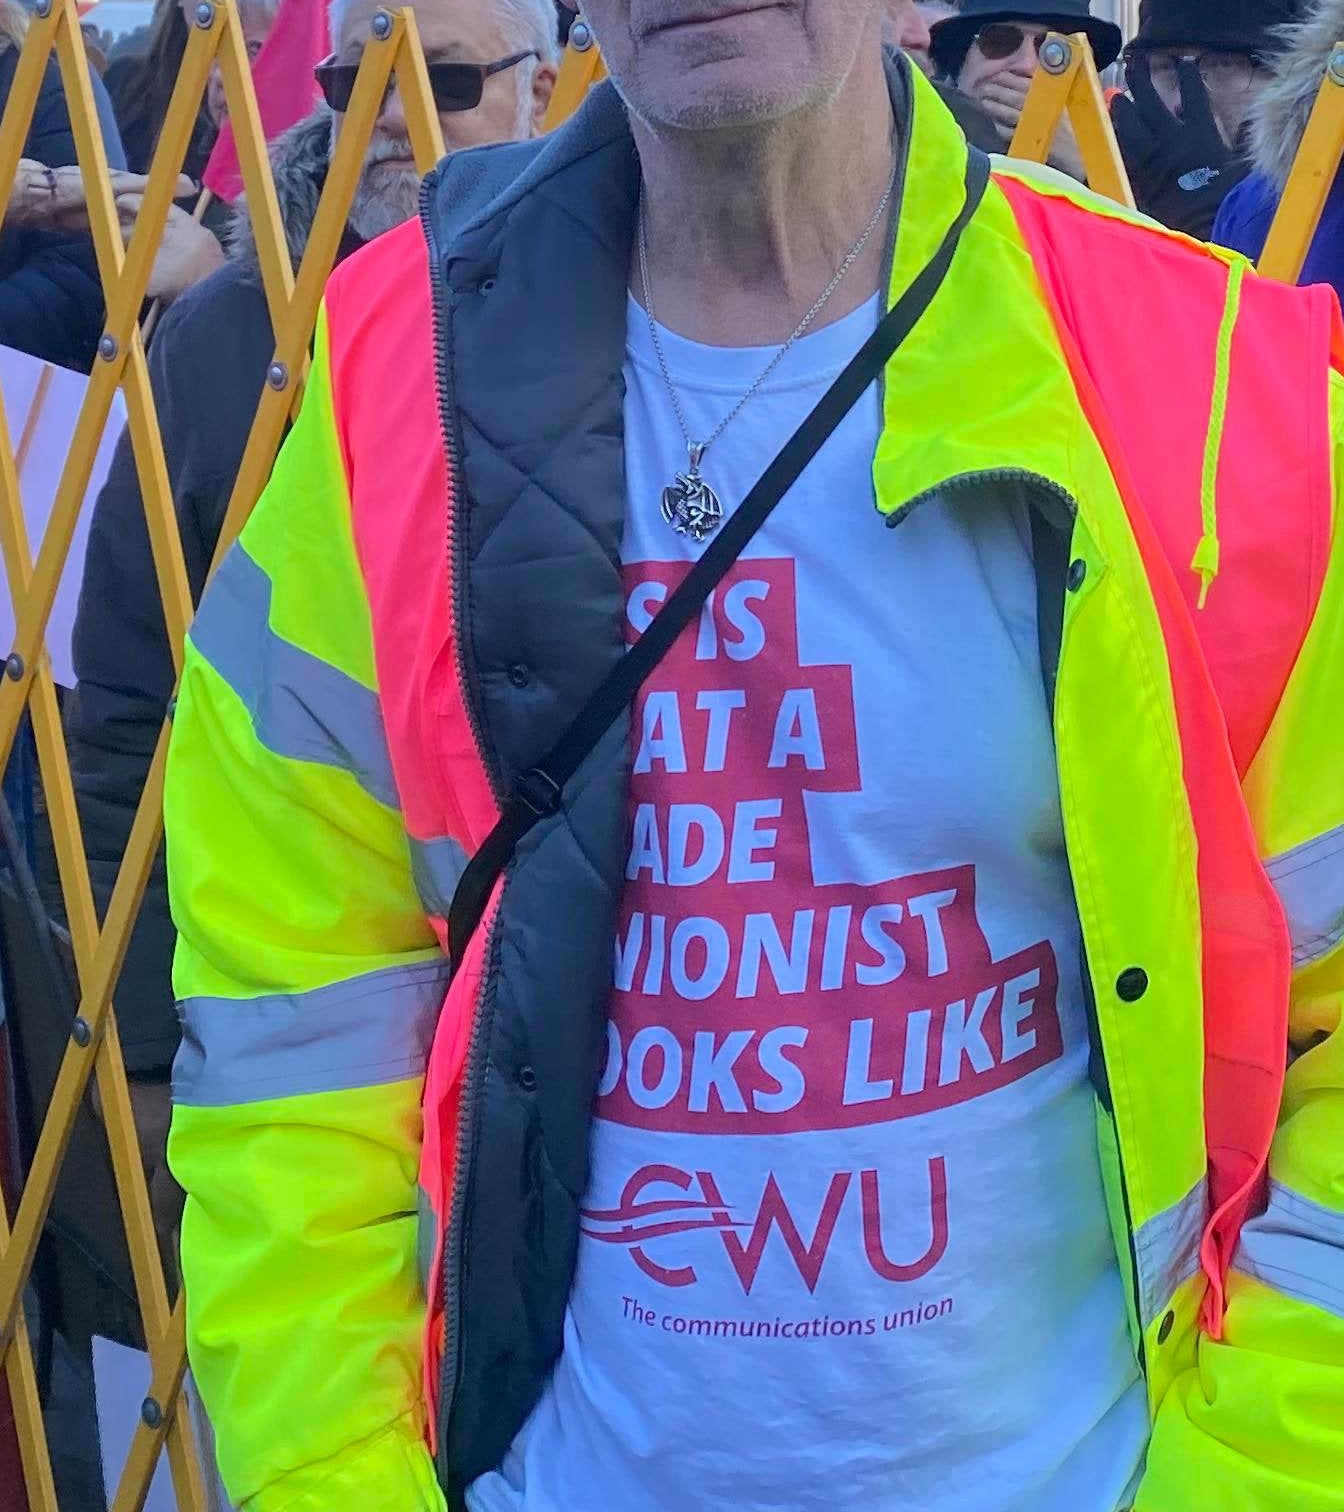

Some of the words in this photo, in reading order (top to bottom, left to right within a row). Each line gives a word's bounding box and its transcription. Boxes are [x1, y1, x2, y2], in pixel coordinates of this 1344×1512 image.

[695, 579, 771, 661] IS
[768, 688, 826, 770] A
[625, 798, 783, 886] ADE
[842, 967, 1041, 1106] LIKE
[582, 1155, 949, 1296] CWU
[621, 1295, 656, 1327] The
[661, 1315, 876, 1339] communications
[883, 1296, 954, 1332] union
